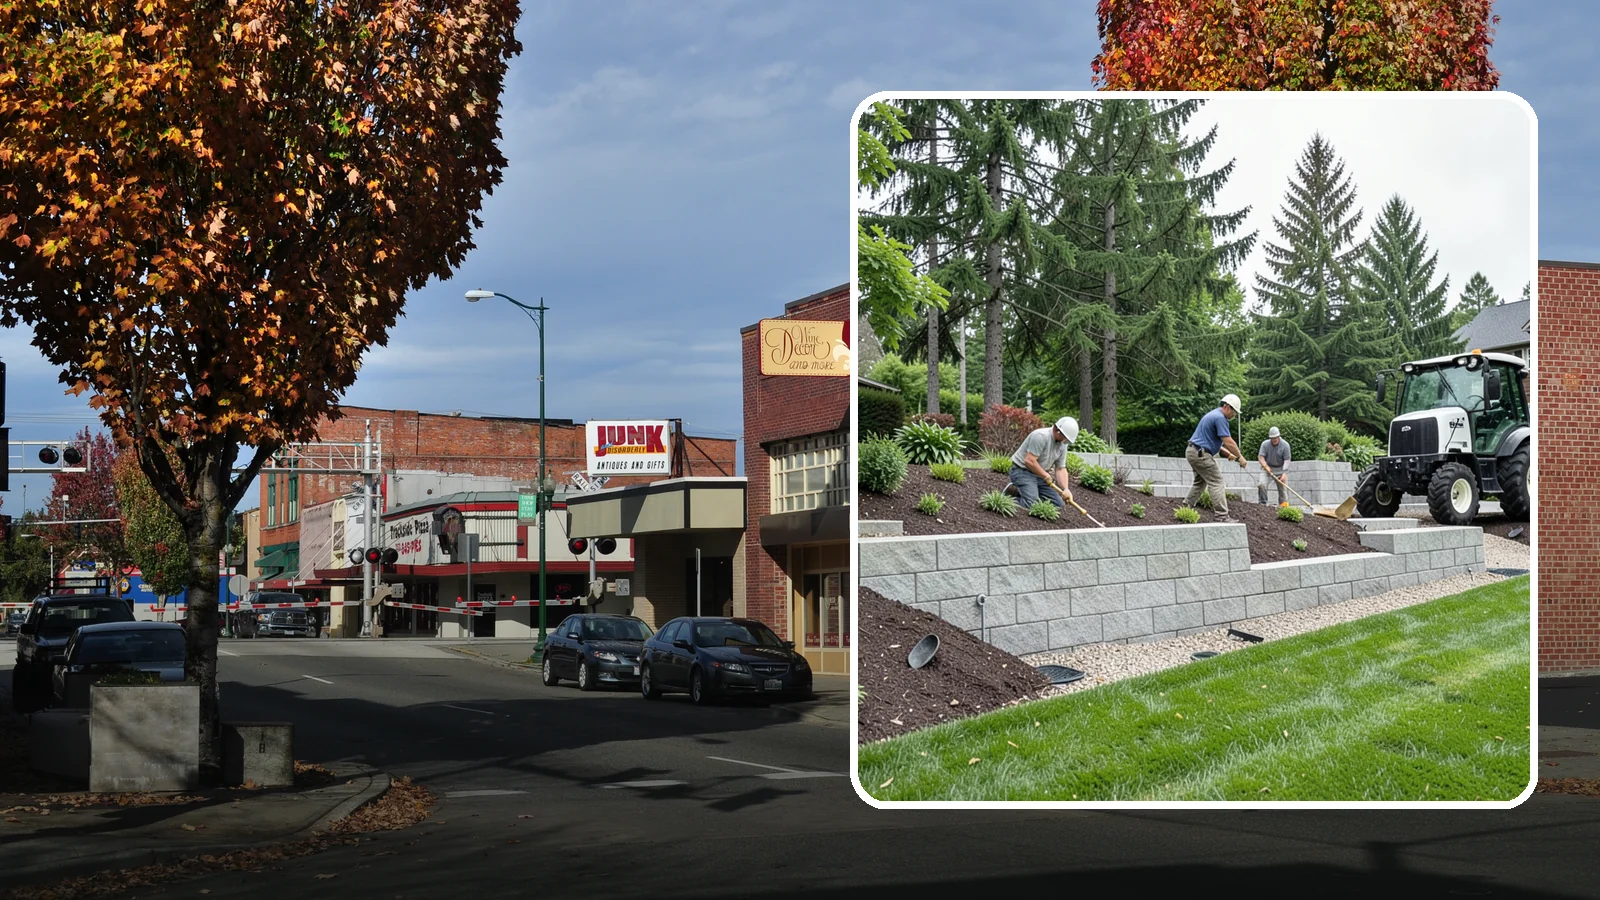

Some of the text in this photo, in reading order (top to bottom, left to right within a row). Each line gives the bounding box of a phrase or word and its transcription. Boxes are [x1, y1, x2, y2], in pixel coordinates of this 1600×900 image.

[595, 425, 665, 457] JUNK
[607, 446, 646, 454] DISORDERLY
[597, 460, 666, 470] ANTIQUES AND GIFTS
[414, 519, 429, 535] Pizza
